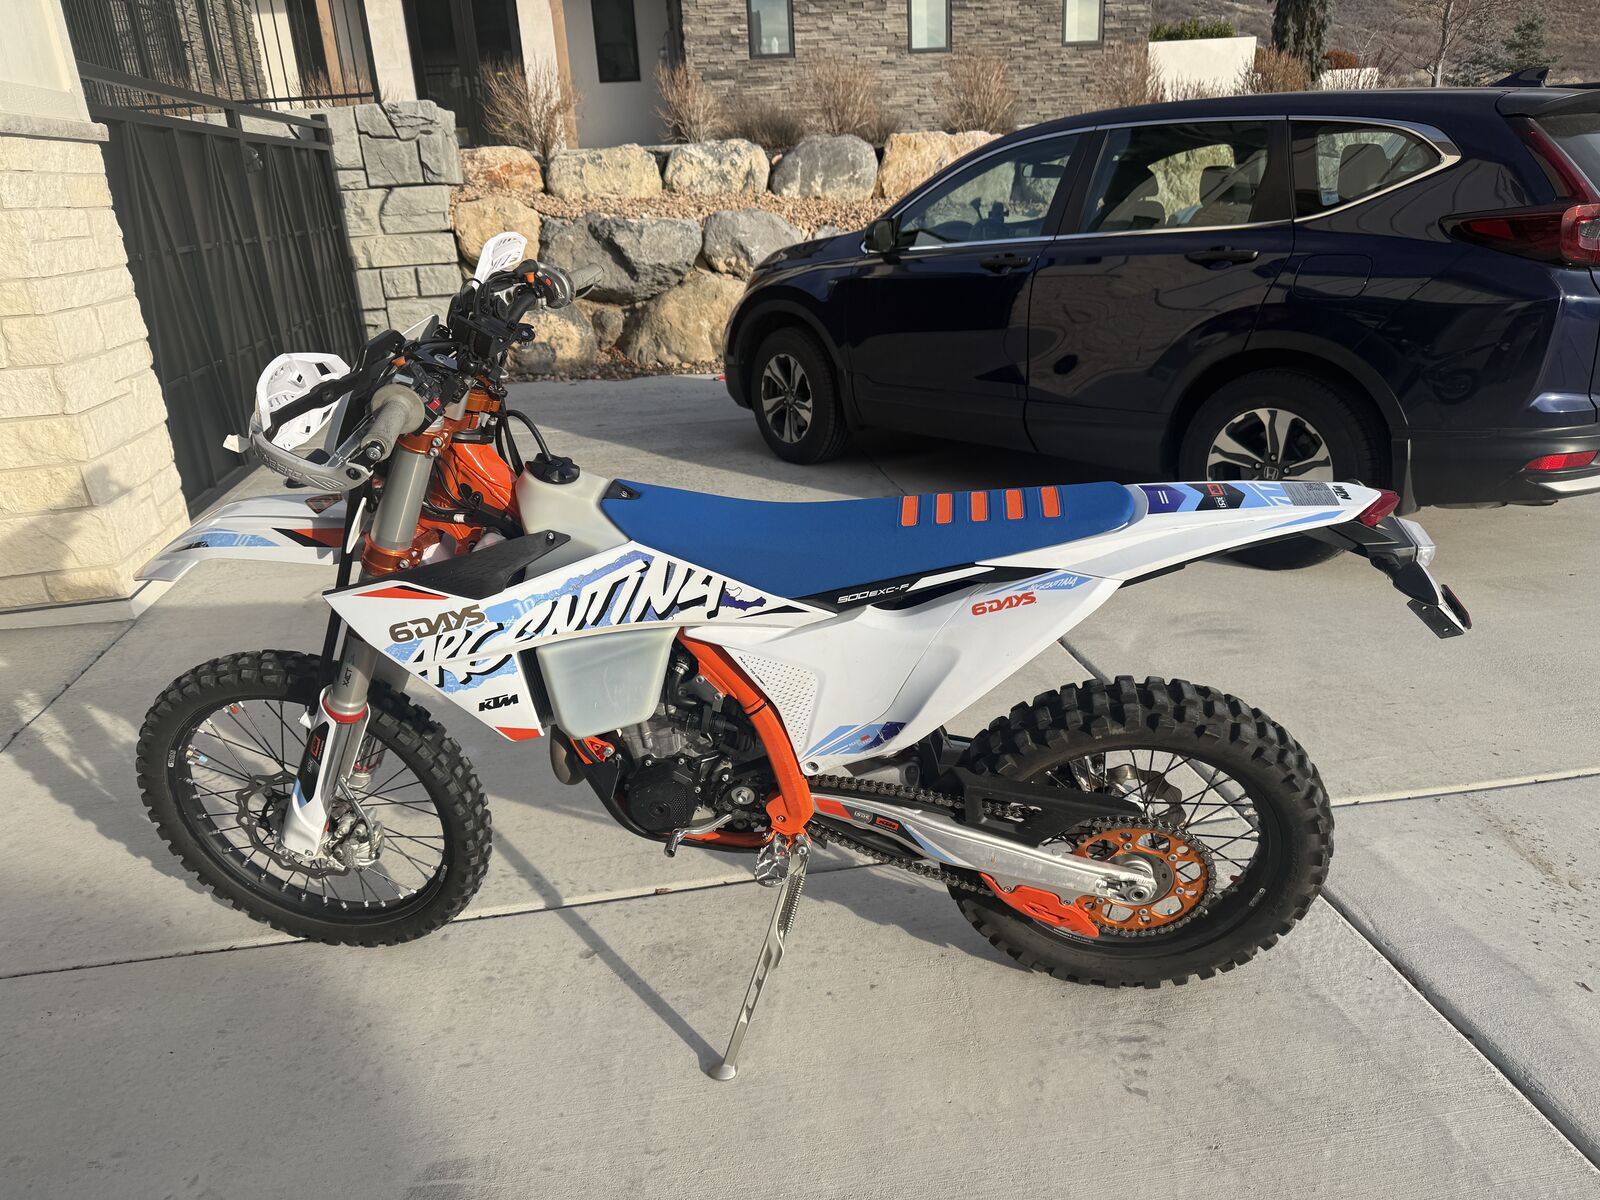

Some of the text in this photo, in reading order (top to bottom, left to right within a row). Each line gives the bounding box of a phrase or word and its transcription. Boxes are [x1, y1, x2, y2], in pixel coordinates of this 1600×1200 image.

[972, 591, 1037, 616] 6DAYS
[389, 604, 486, 643] 6DAYS
[478, 694, 519, 712] KTM
